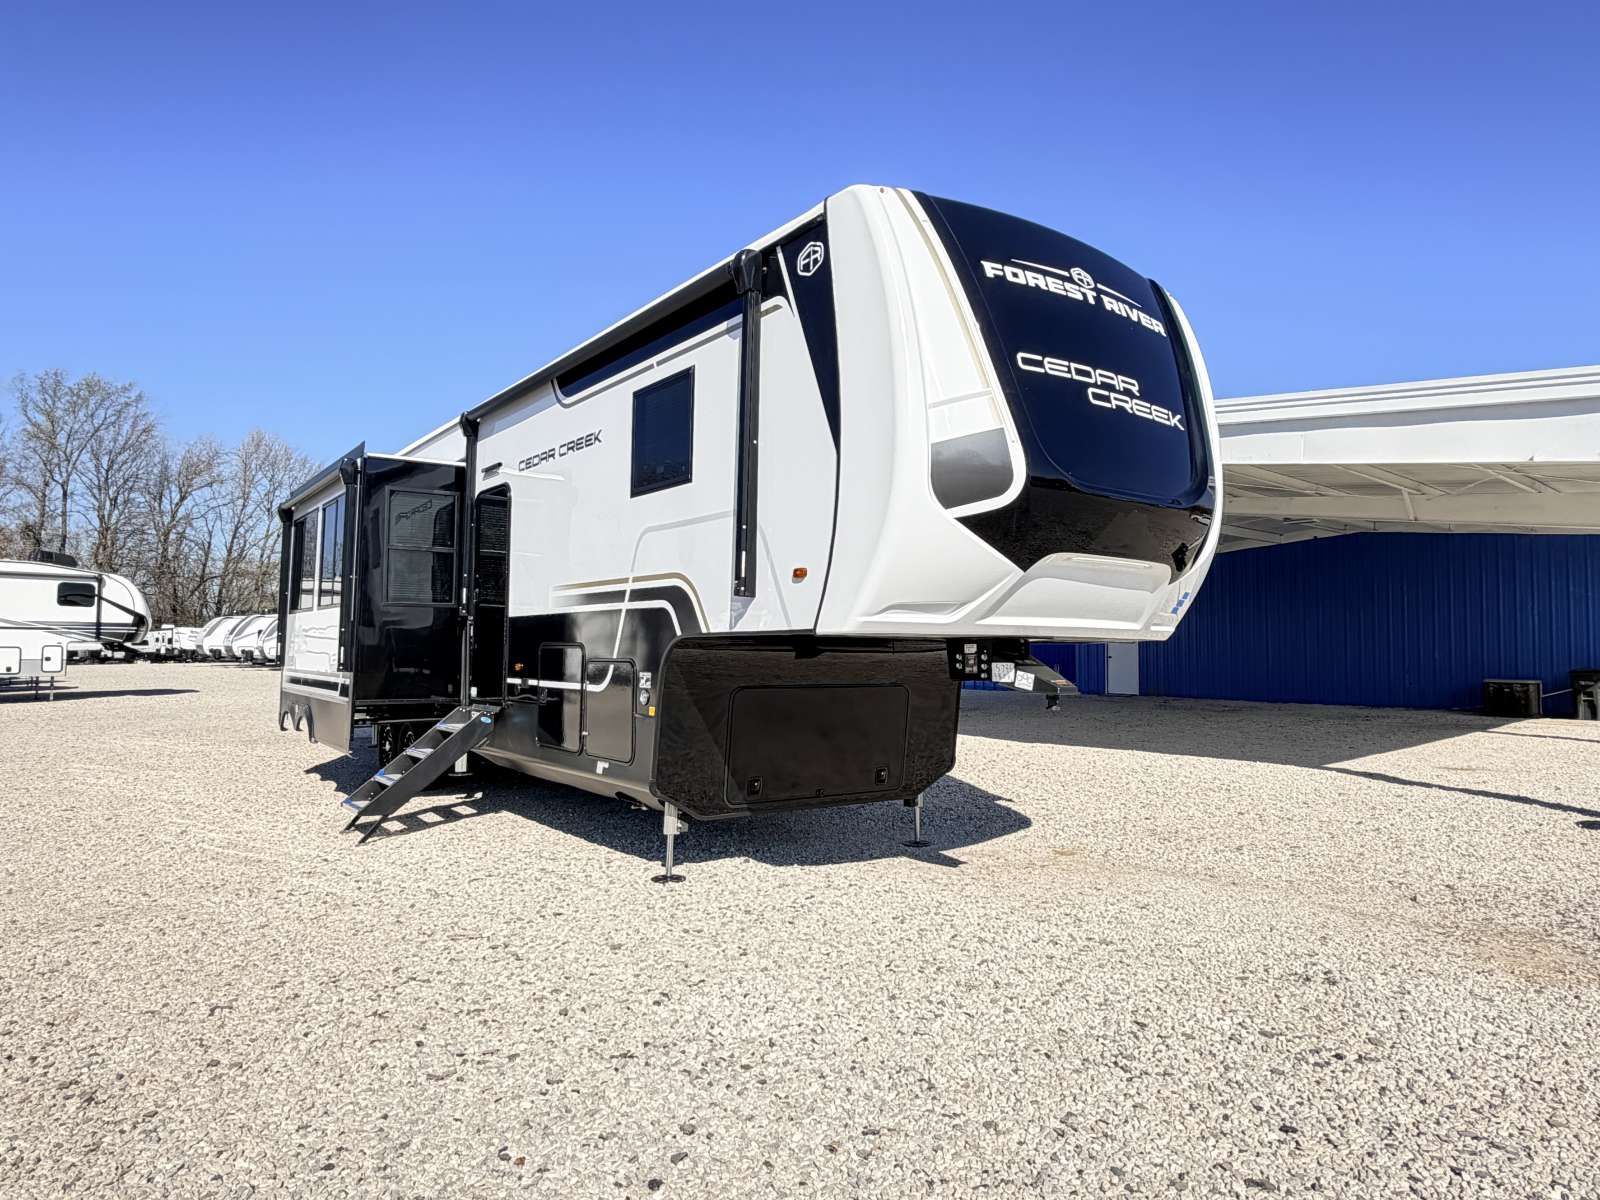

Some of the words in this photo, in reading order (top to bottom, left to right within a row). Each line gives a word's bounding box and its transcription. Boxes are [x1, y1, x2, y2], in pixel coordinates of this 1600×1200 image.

[981, 261, 1097, 305] FOREST
[1099, 295, 1167, 337] RIVER
[1016, 351, 1141, 397] CEDAR
[1088, 387, 1185, 431] CREEK
[518, 447, 556, 472] CEDAR
[558, 429, 602, 458] CREEK
